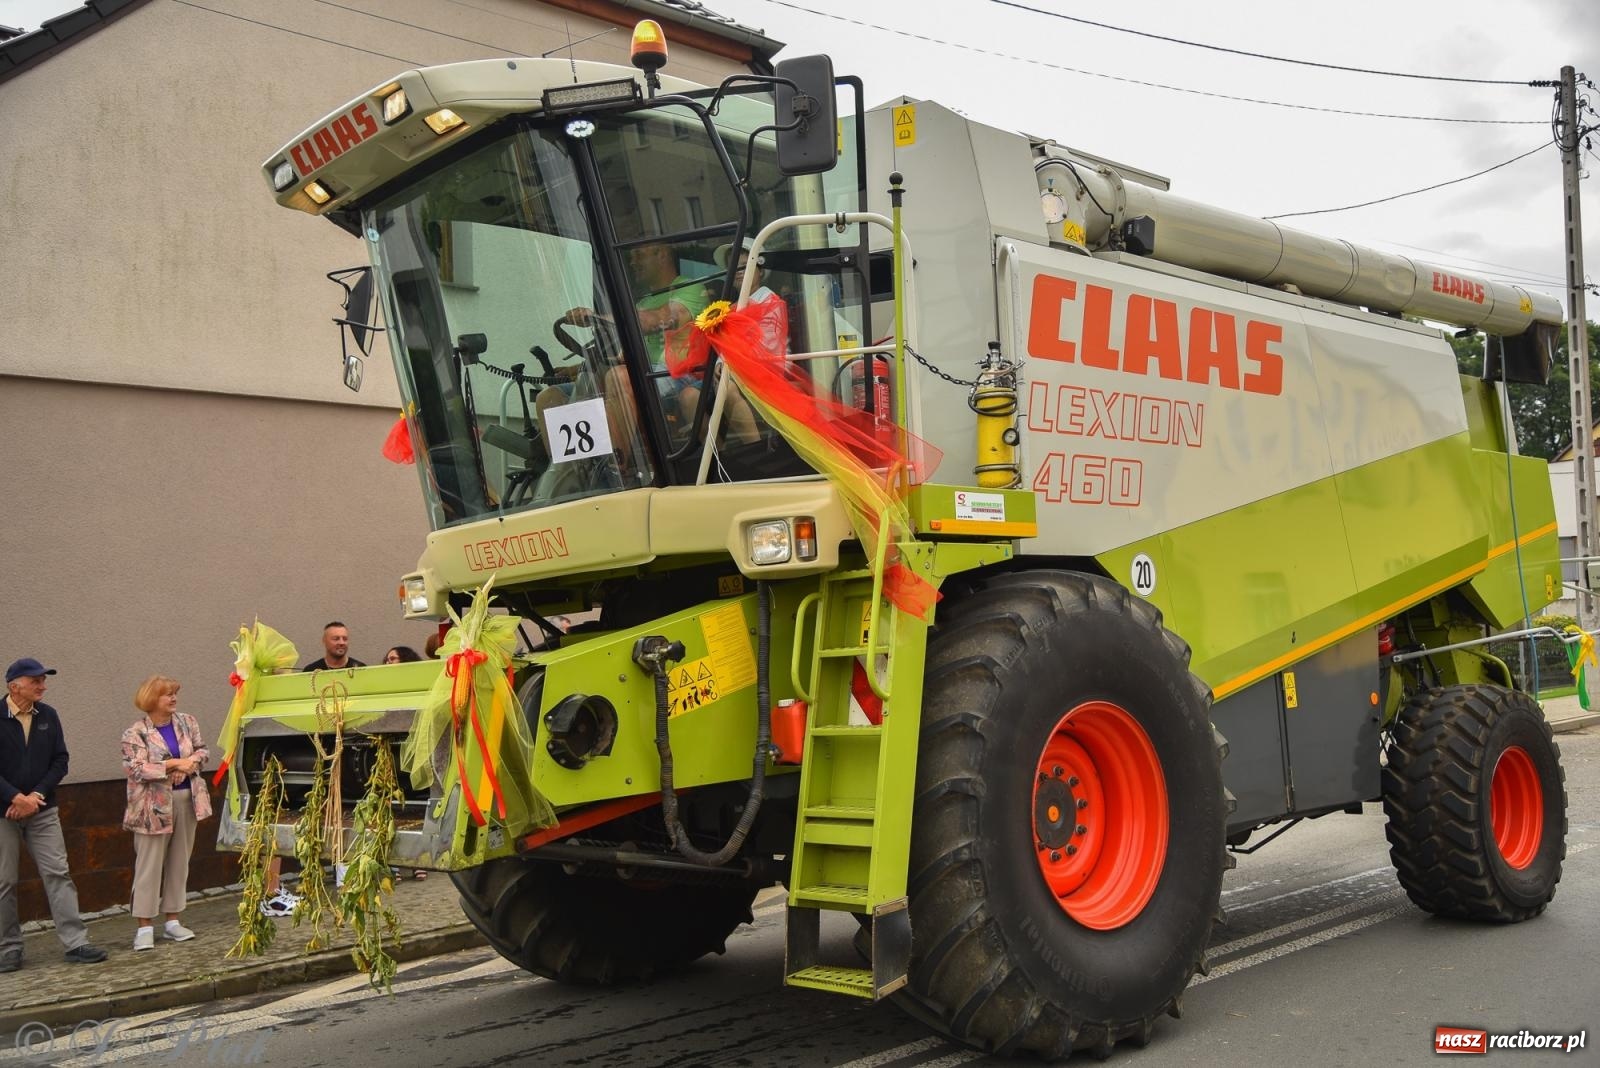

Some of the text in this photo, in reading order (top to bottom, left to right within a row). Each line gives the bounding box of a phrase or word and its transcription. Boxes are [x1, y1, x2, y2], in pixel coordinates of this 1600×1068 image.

[290, 102, 378, 177] CLAAS
[1431, 271, 1485, 305] CLAAS
[1027, 273, 1284, 396] CLAAS
[559, 420, 595, 457] 28
[1027, 381, 1204, 449] LEXION
[1033, 452, 1143, 507] 460
[463, 526, 569, 572] LEXION
[1135, 560, 1152, 589] 20
